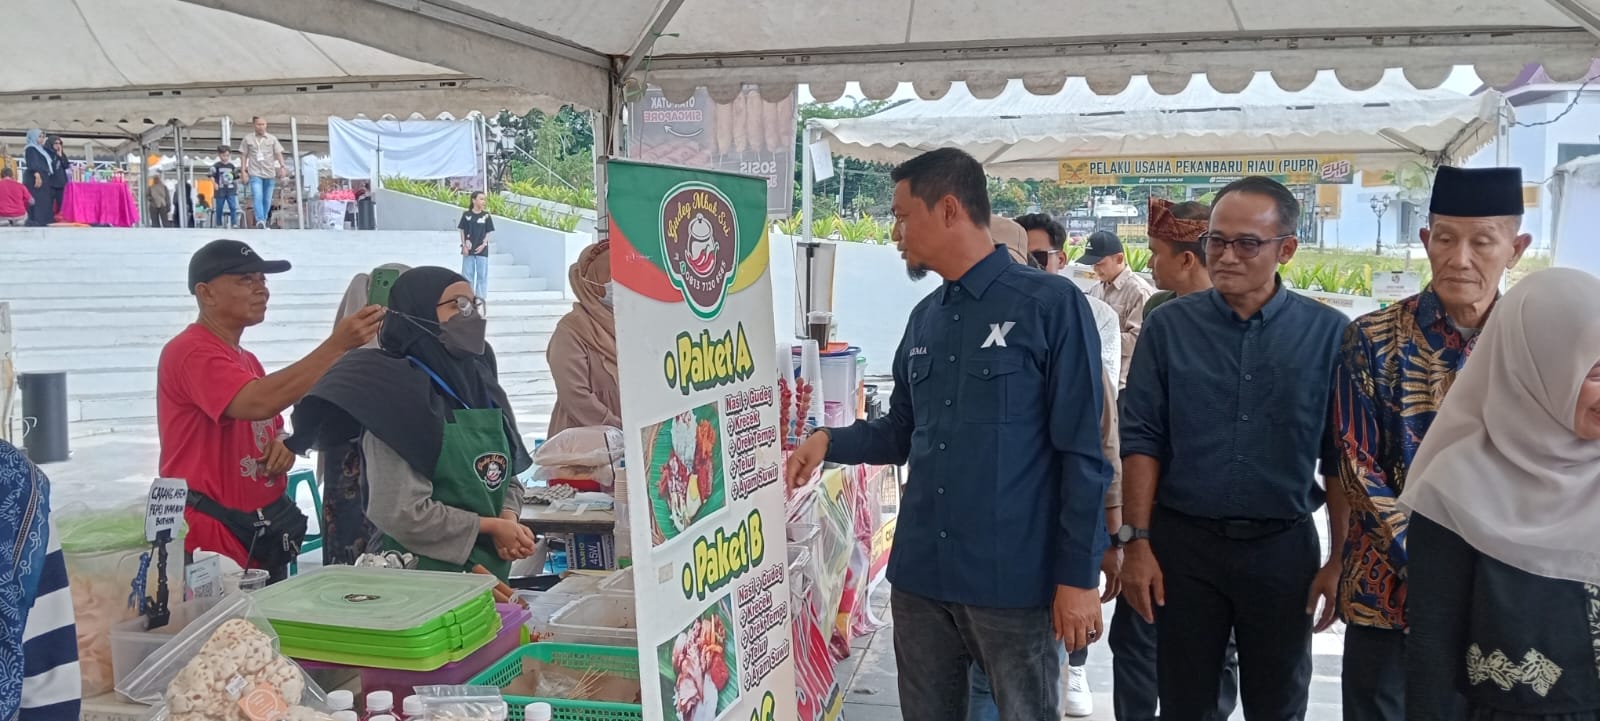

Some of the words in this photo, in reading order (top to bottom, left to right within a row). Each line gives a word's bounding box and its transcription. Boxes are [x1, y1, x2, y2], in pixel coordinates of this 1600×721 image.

[1089, 160, 1131, 175] PELAKU
[1135, 160, 1172, 174] USAHA
[1175, 160, 1242, 174] PEKANBARU
[1247, 159, 1275, 173] RIAU
[1278, 158, 1318, 174] (PUPR)
[667, 201, 692, 243] Gudeg
[692, 192, 718, 217] Mbak
[718, 212, 731, 237] Sri
[702, 279, 716, 291] 7120
[676, 328, 736, 396] Paket
[735, 321, 754, 380] A
[725, 391, 743, 415] Nasi
[749, 385, 773, 407] Gudeg
[735, 408, 760, 434] Krecek
[736, 433, 754, 455] Orek
[753, 425, 776, 447] Tempe
[737, 453, 756, 476] Telur
[739, 473, 758, 499] Ayam
[758, 462, 778, 488] Suwir
[588, 544, 598, 564] 45W
[693, 519, 749, 601] Paket
[748, 508, 764, 568] B
[737, 577, 755, 608] Nasi
[762, 563, 784, 590] Gudeg
[747, 590, 772, 624] Krecek
[749, 617, 766, 644] Orek
[765, 601, 787, 631] Tempe
[750, 636, 768, 665] Telur
[751, 655, 771, 687] Ayam
